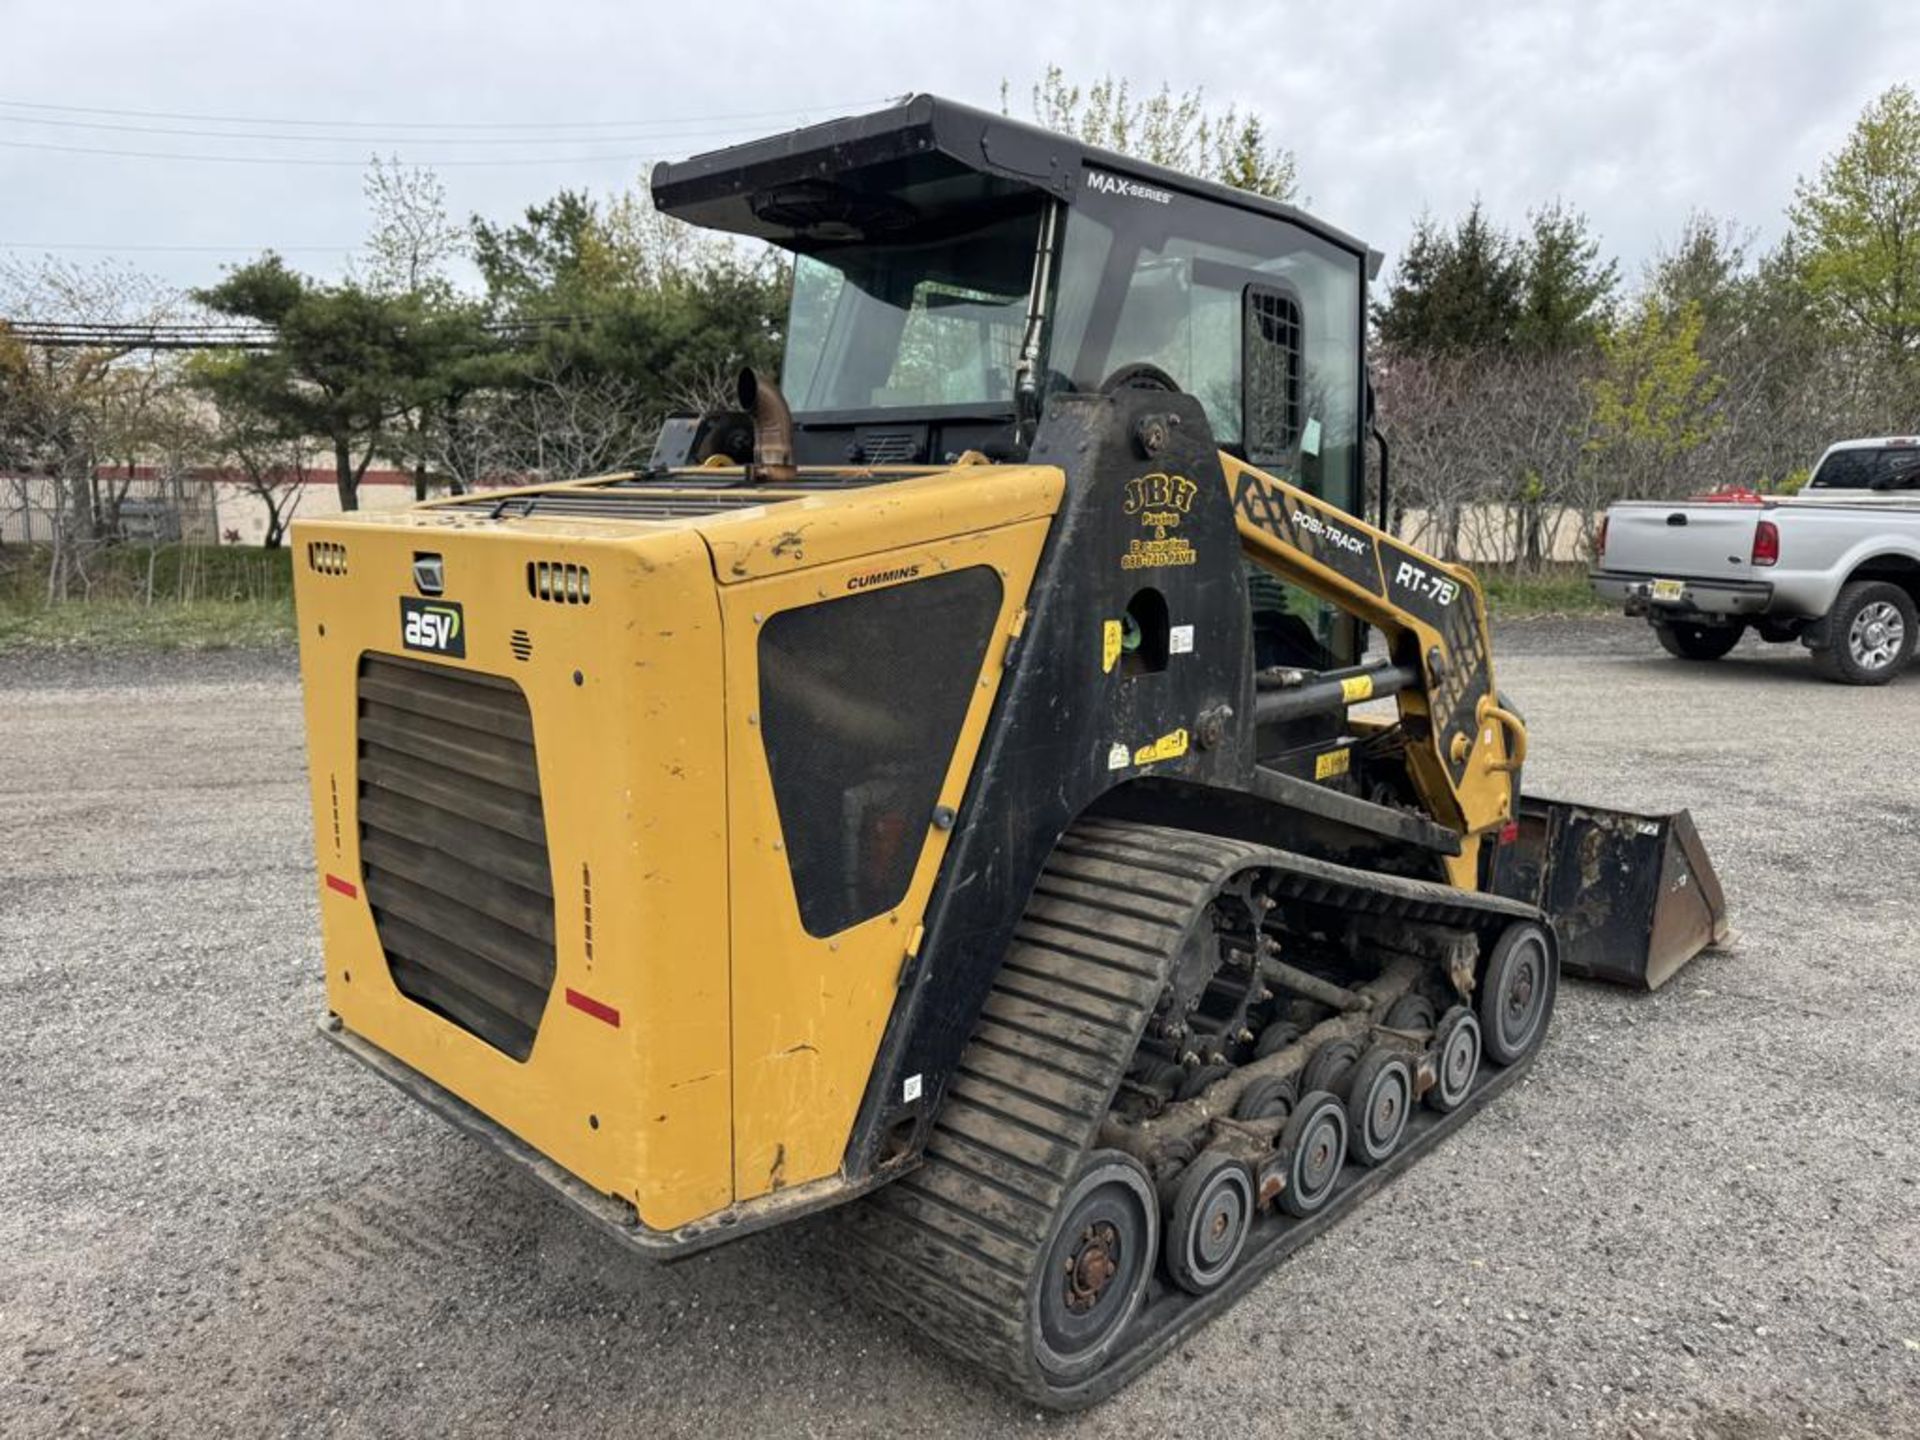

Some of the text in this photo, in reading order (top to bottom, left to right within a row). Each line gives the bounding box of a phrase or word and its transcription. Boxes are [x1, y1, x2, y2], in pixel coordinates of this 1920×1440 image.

[1291, 510, 1366, 555] POSI-TRACK
[846, 565, 920, 590] CUMMINS
[1395, 561, 1454, 606] RT-75
